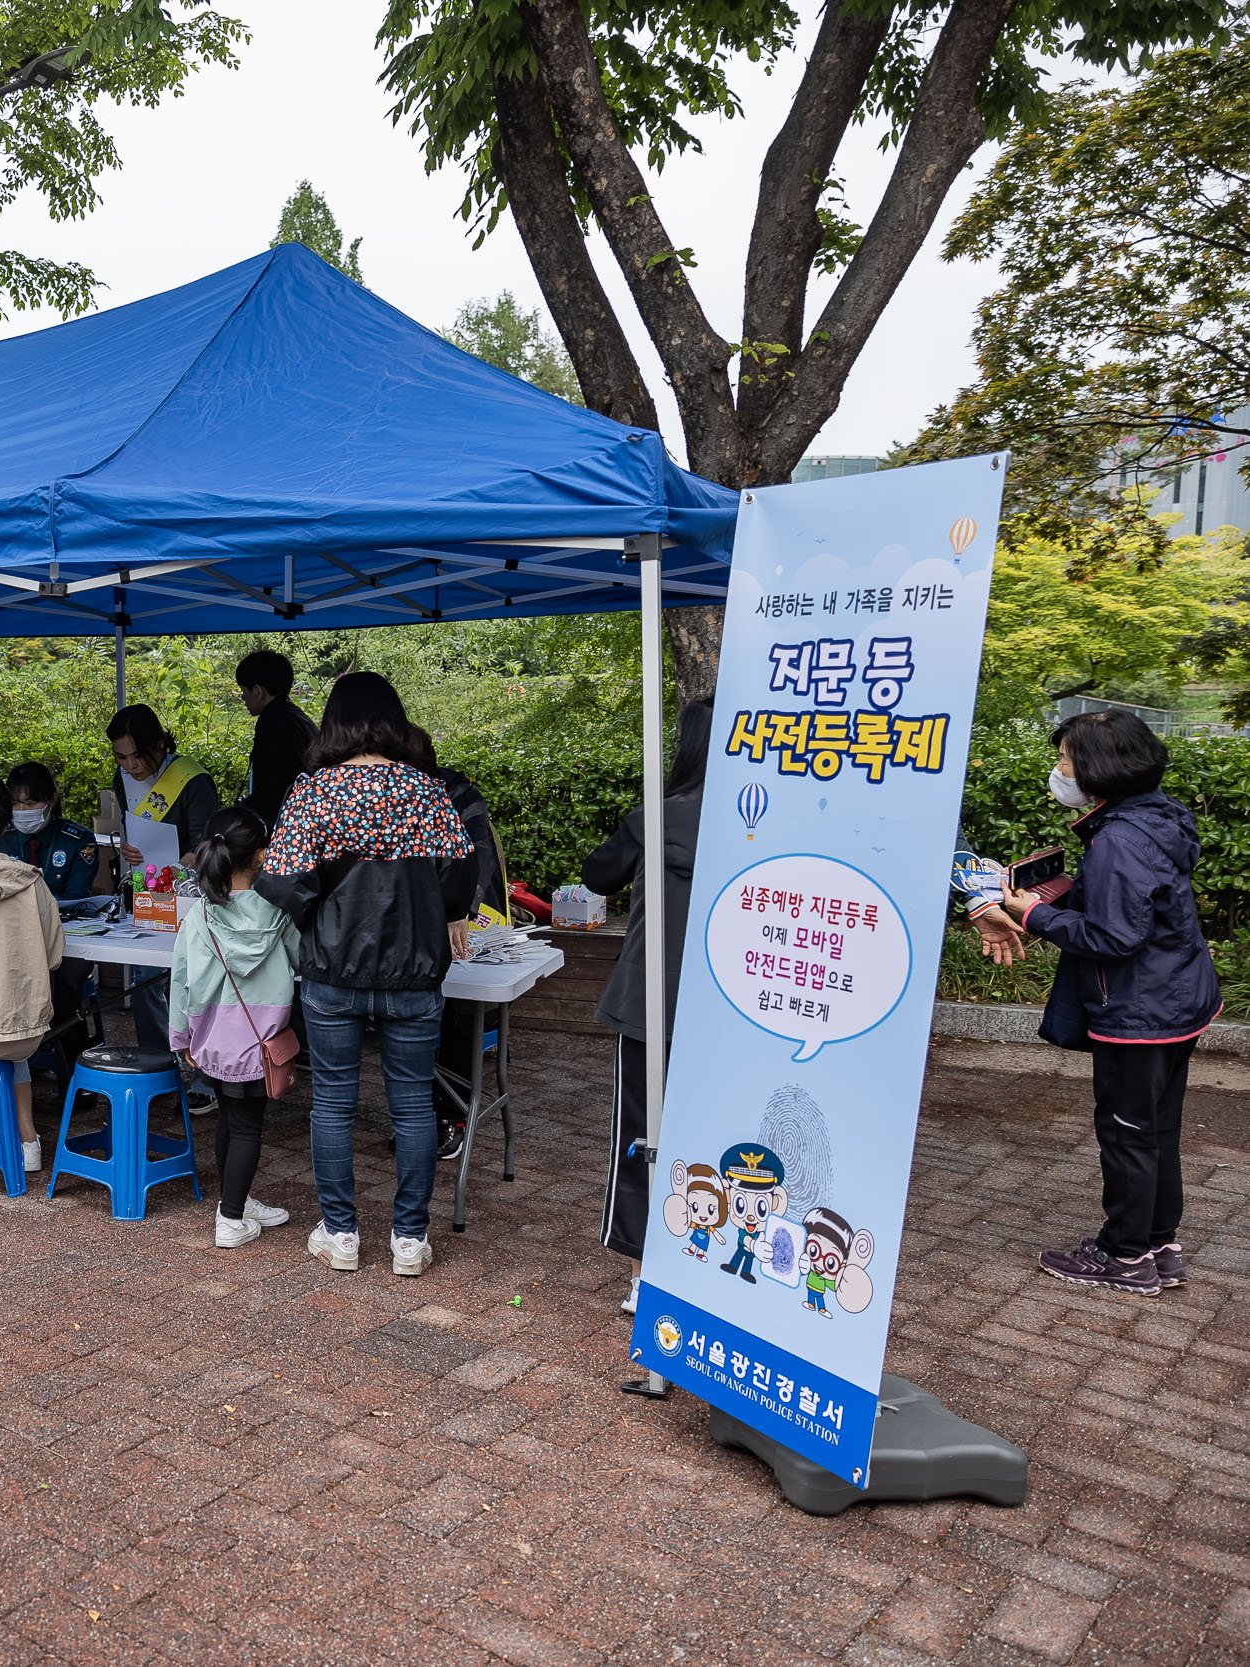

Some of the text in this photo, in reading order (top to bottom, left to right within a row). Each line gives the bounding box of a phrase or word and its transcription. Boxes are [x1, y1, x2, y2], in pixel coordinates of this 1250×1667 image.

[755, 583, 954, 618] 사랑하는 내 가족을 지키는
[769, 636, 914, 711] 지문 등
[726, 710, 951, 785] 사전등록제
[740, 885, 879, 932] 실종예방 지문등록
[762, 924, 844, 960] 이제 모바일
[744, 949, 854, 993] 안전드림앱으로
[758, 989, 830, 1023] 쉽고 빠르게
[685, 1355, 840, 1446] SEOUL GWANGJIN POLICE STATION
[687, 1330, 845, 1430] 서울광진경찰서
